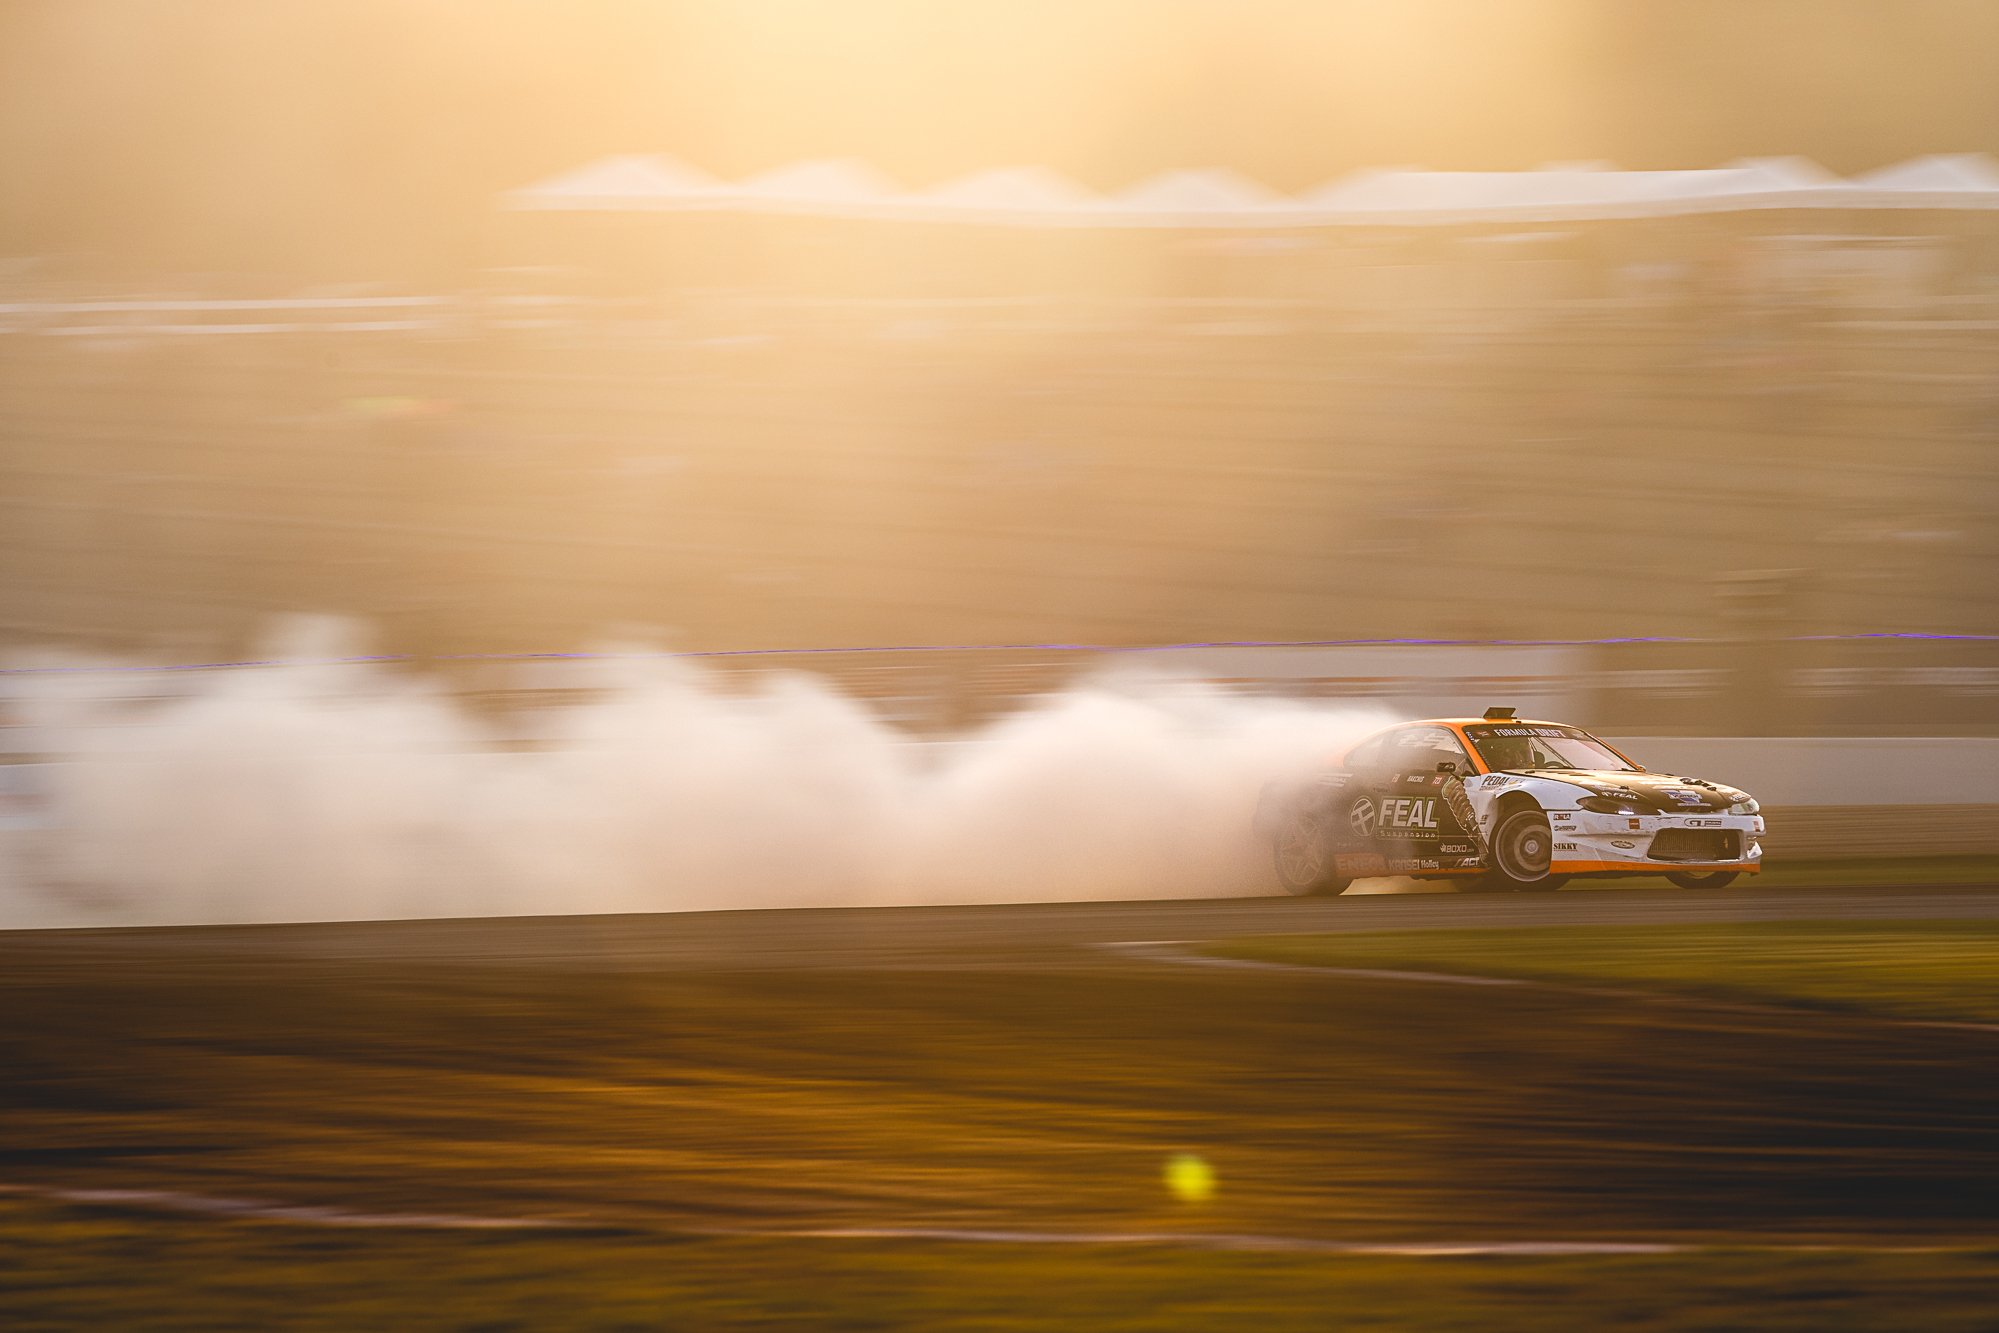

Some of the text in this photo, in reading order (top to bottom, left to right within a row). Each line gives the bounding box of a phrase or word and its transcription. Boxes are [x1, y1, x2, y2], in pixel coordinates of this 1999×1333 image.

[1494, 728, 1567, 738] FORMULA DRIFT
[1613, 792, 1638, 800] FEAL
[1378, 799, 1437, 828] FEAL
[1421, 859, 1440, 870] Holley
[1460, 857, 1480, 867] ACT
